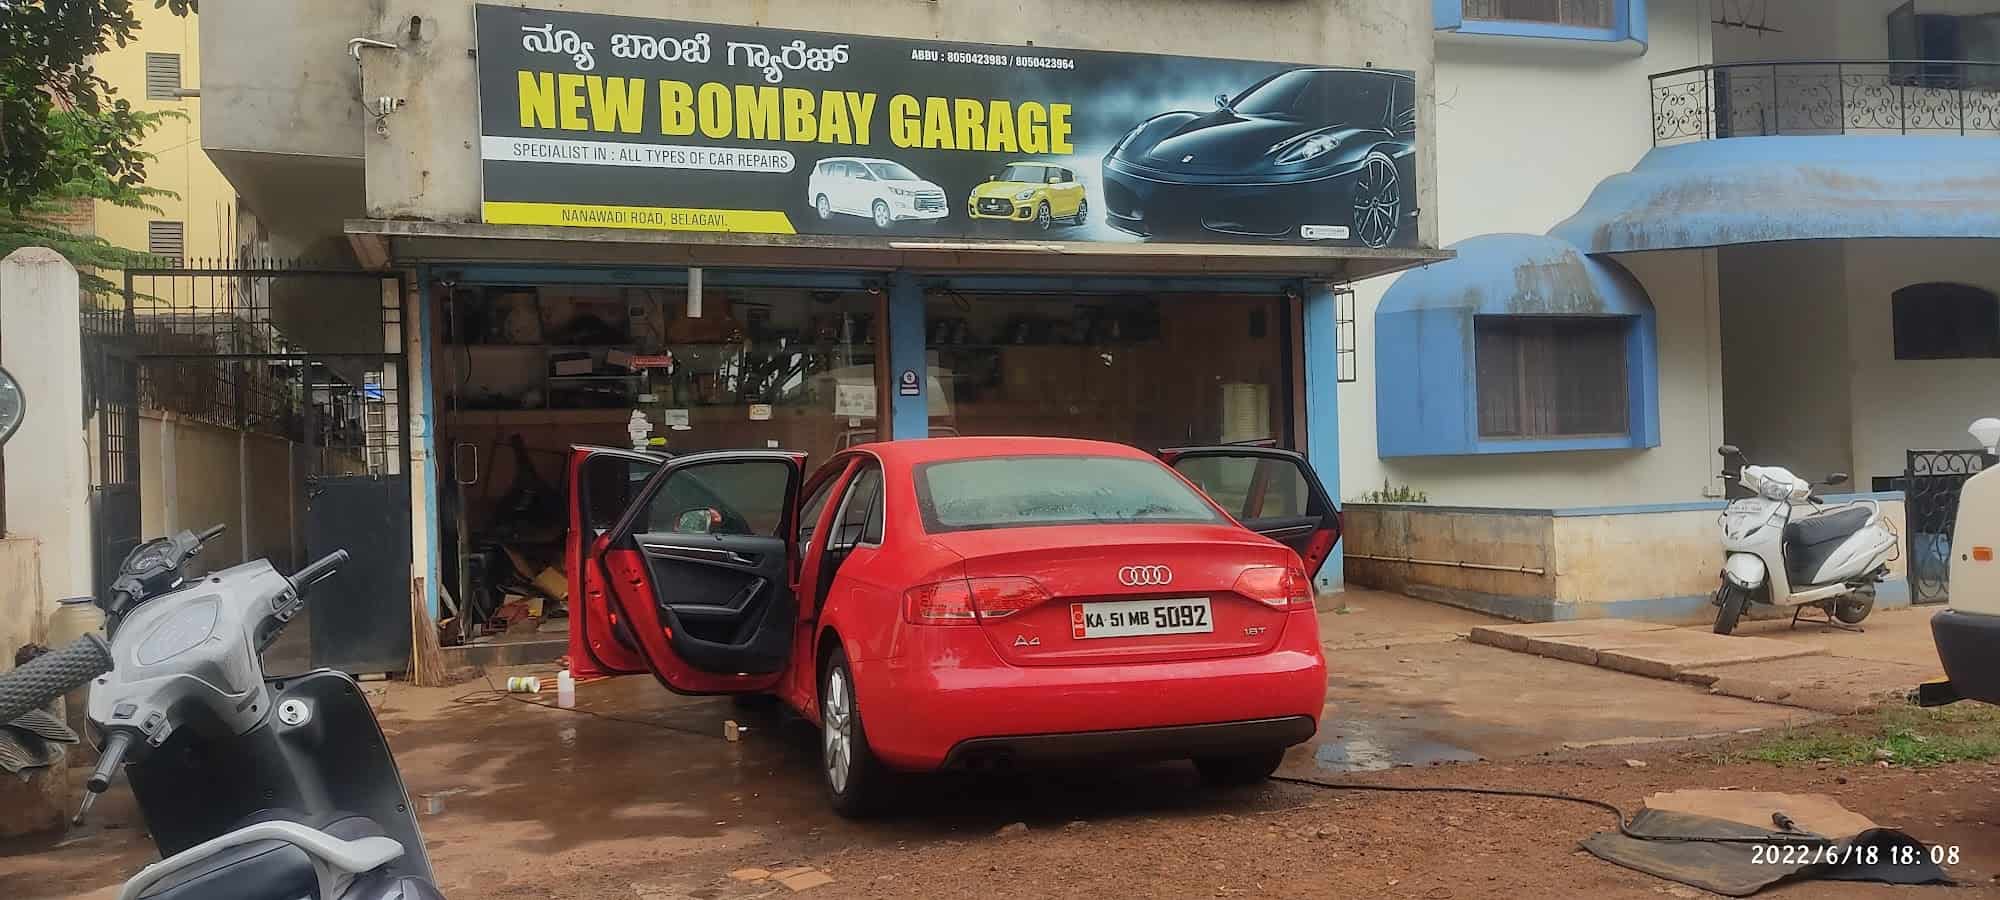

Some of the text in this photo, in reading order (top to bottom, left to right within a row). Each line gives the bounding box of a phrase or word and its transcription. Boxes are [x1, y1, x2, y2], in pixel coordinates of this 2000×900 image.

[521, 23, 596, 71] ನ್ಯೂ
[610, 32, 711, 64] ಬಾಂಬೆ
[911, 49, 938, 61] ABBU
[518, 70, 1073, 155] NEW BOMBAY GARAGE
[513, 143, 588, 160] SPECIALIST
[594, 147, 607, 161] IN
[619, 149, 642, 162] ALL
[646, 149, 686, 164] TYPES
[689, 152, 704, 164] OF
[709, 152, 734, 166] CAR
[737, 154, 788, 168] REPAIRS
[562, 209, 627, 224] NANAWADI
[631, 211, 666, 226] ROAD,
[1086, 604, 1208, 629] KA 51 MB 5092
[1014, 634, 1041, 646] A4
